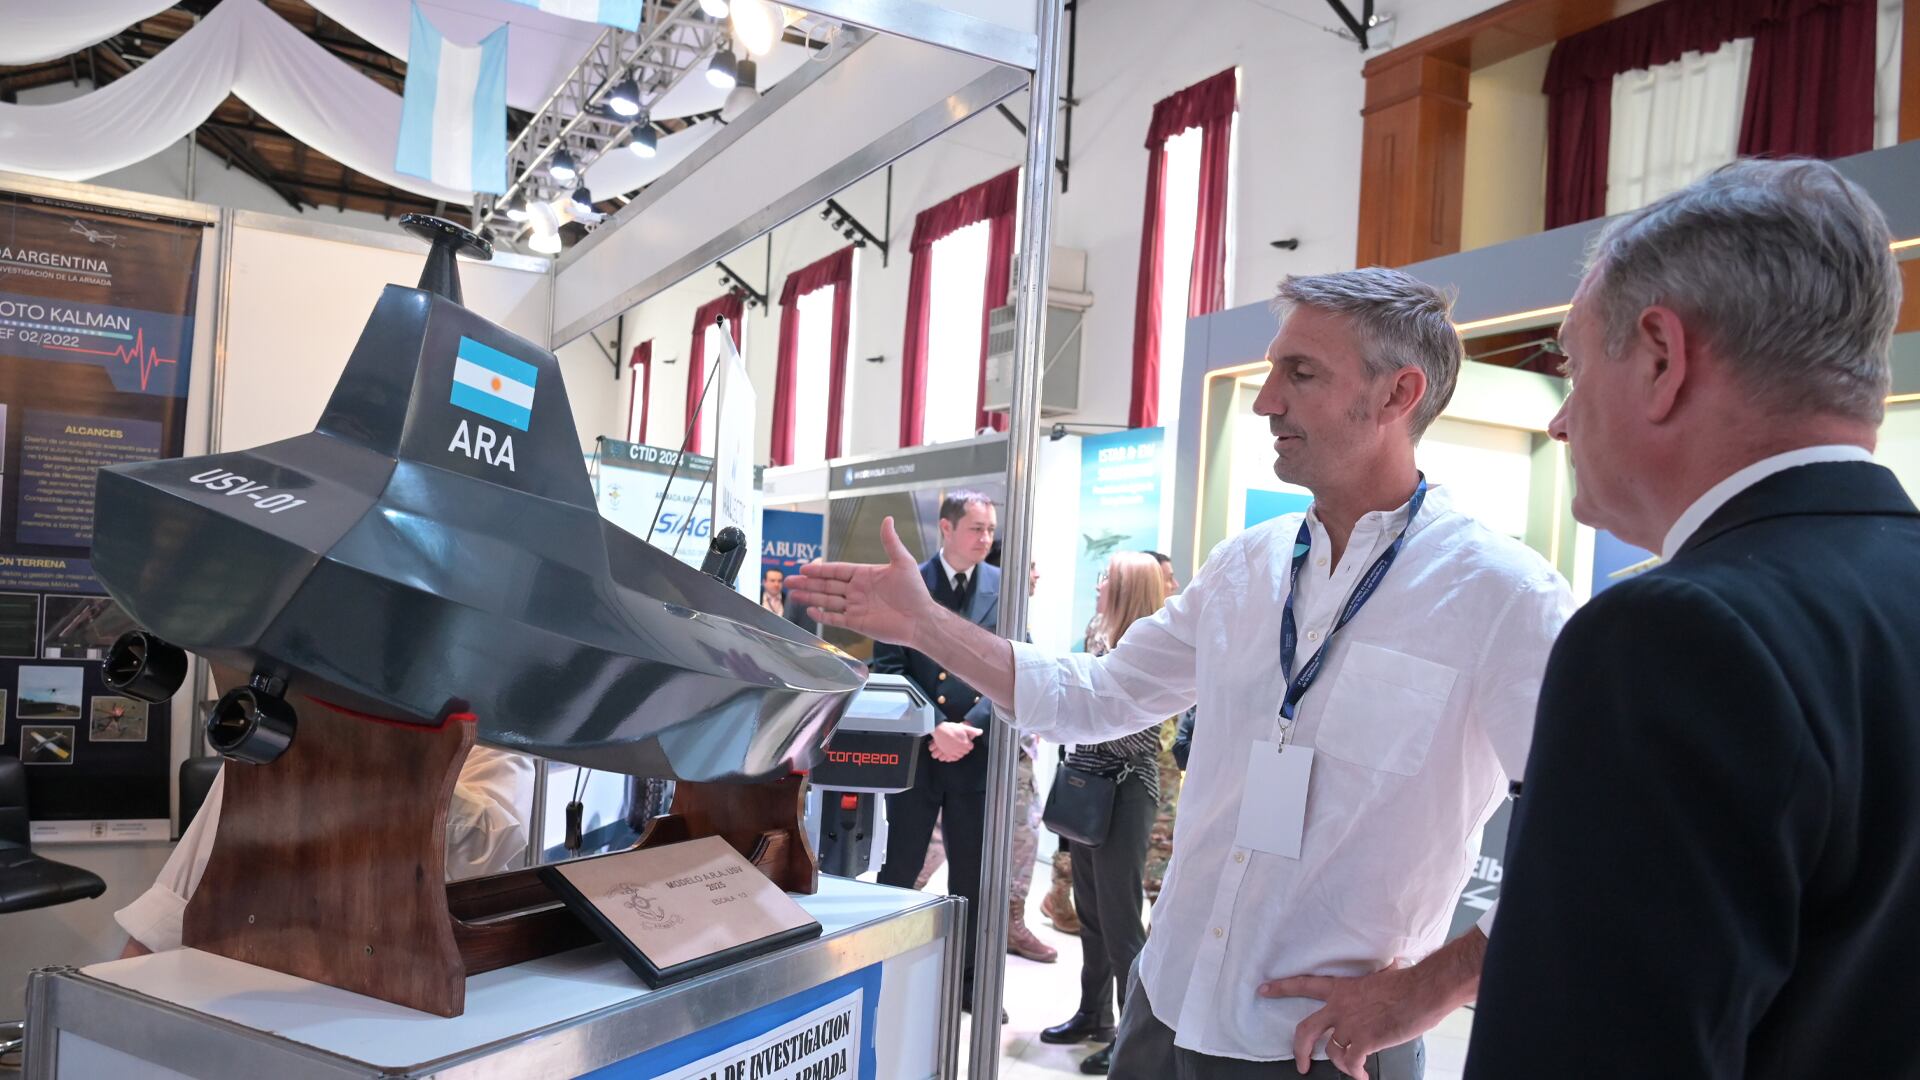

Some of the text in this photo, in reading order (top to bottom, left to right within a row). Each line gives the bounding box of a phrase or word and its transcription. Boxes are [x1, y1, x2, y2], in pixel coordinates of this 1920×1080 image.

[0, 247, 108, 273] A ARGENTINA
[68, 274, 78, 282] LA
[79, 276, 112, 286] ARMADA
[0, 301, 130, 331] OTO KALMAN
[19, 330, 80, 347] 02/2022
[64, 425, 124, 439] ALCANCES
[448, 419, 515, 472] ARA
[629, 445, 658, 464] CTID
[189, 468, 307, 514] USV-01
[16, 558, 66, 568] TERRENA
[665, 875, 703, 889] MODELO
[727, 866, 743, 876] USV
[705, 881, 727, 892] 2025
[725, 1011, 851, 1080] DE INVESTIGACION
